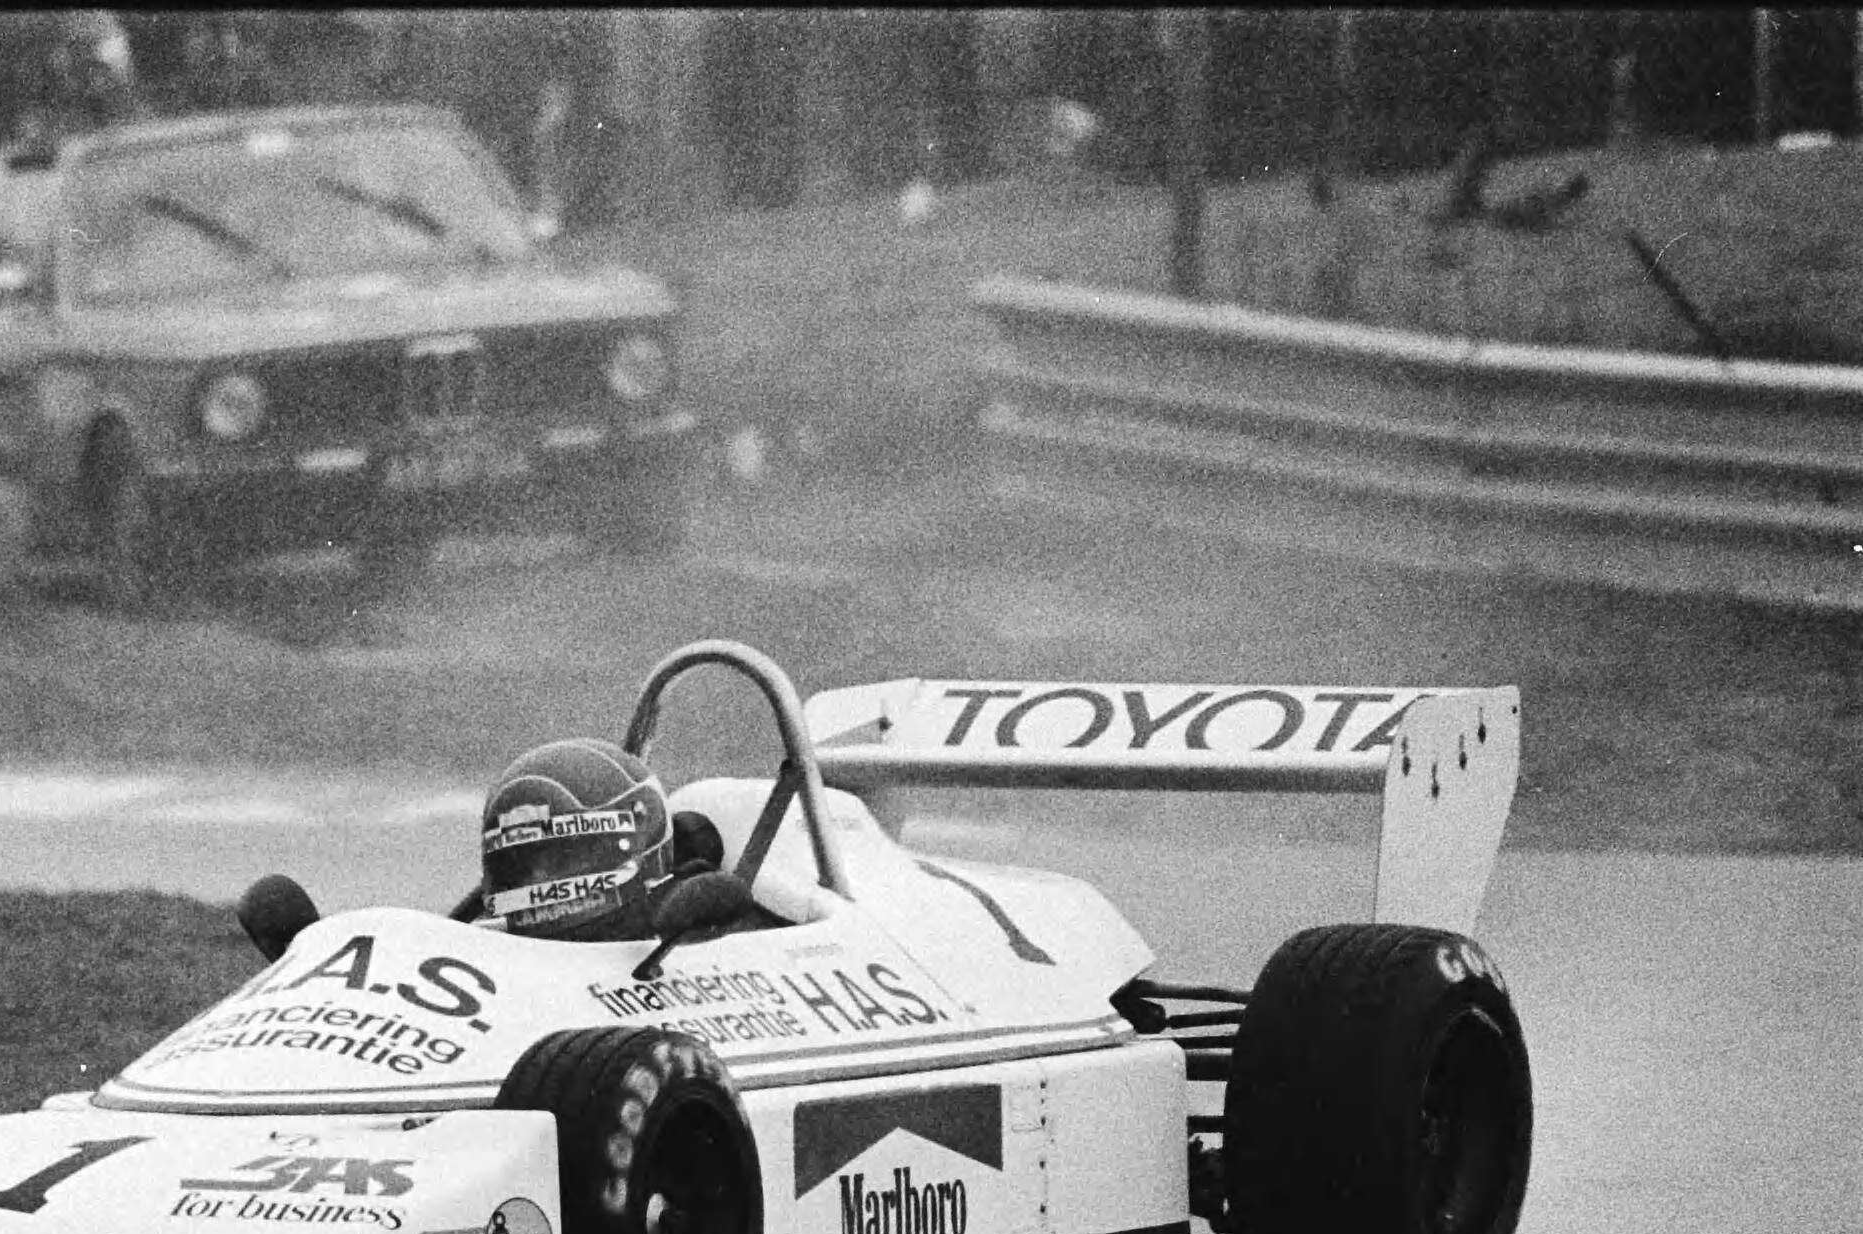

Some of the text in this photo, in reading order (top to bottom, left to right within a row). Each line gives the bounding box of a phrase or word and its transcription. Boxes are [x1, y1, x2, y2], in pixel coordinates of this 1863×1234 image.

[541, 813, 617, 838] Marlboro
[529, 881, 571, 905] HAS
[588, 964, 786, 1018] financiering
[170, 1193, 406, 1231] for business
